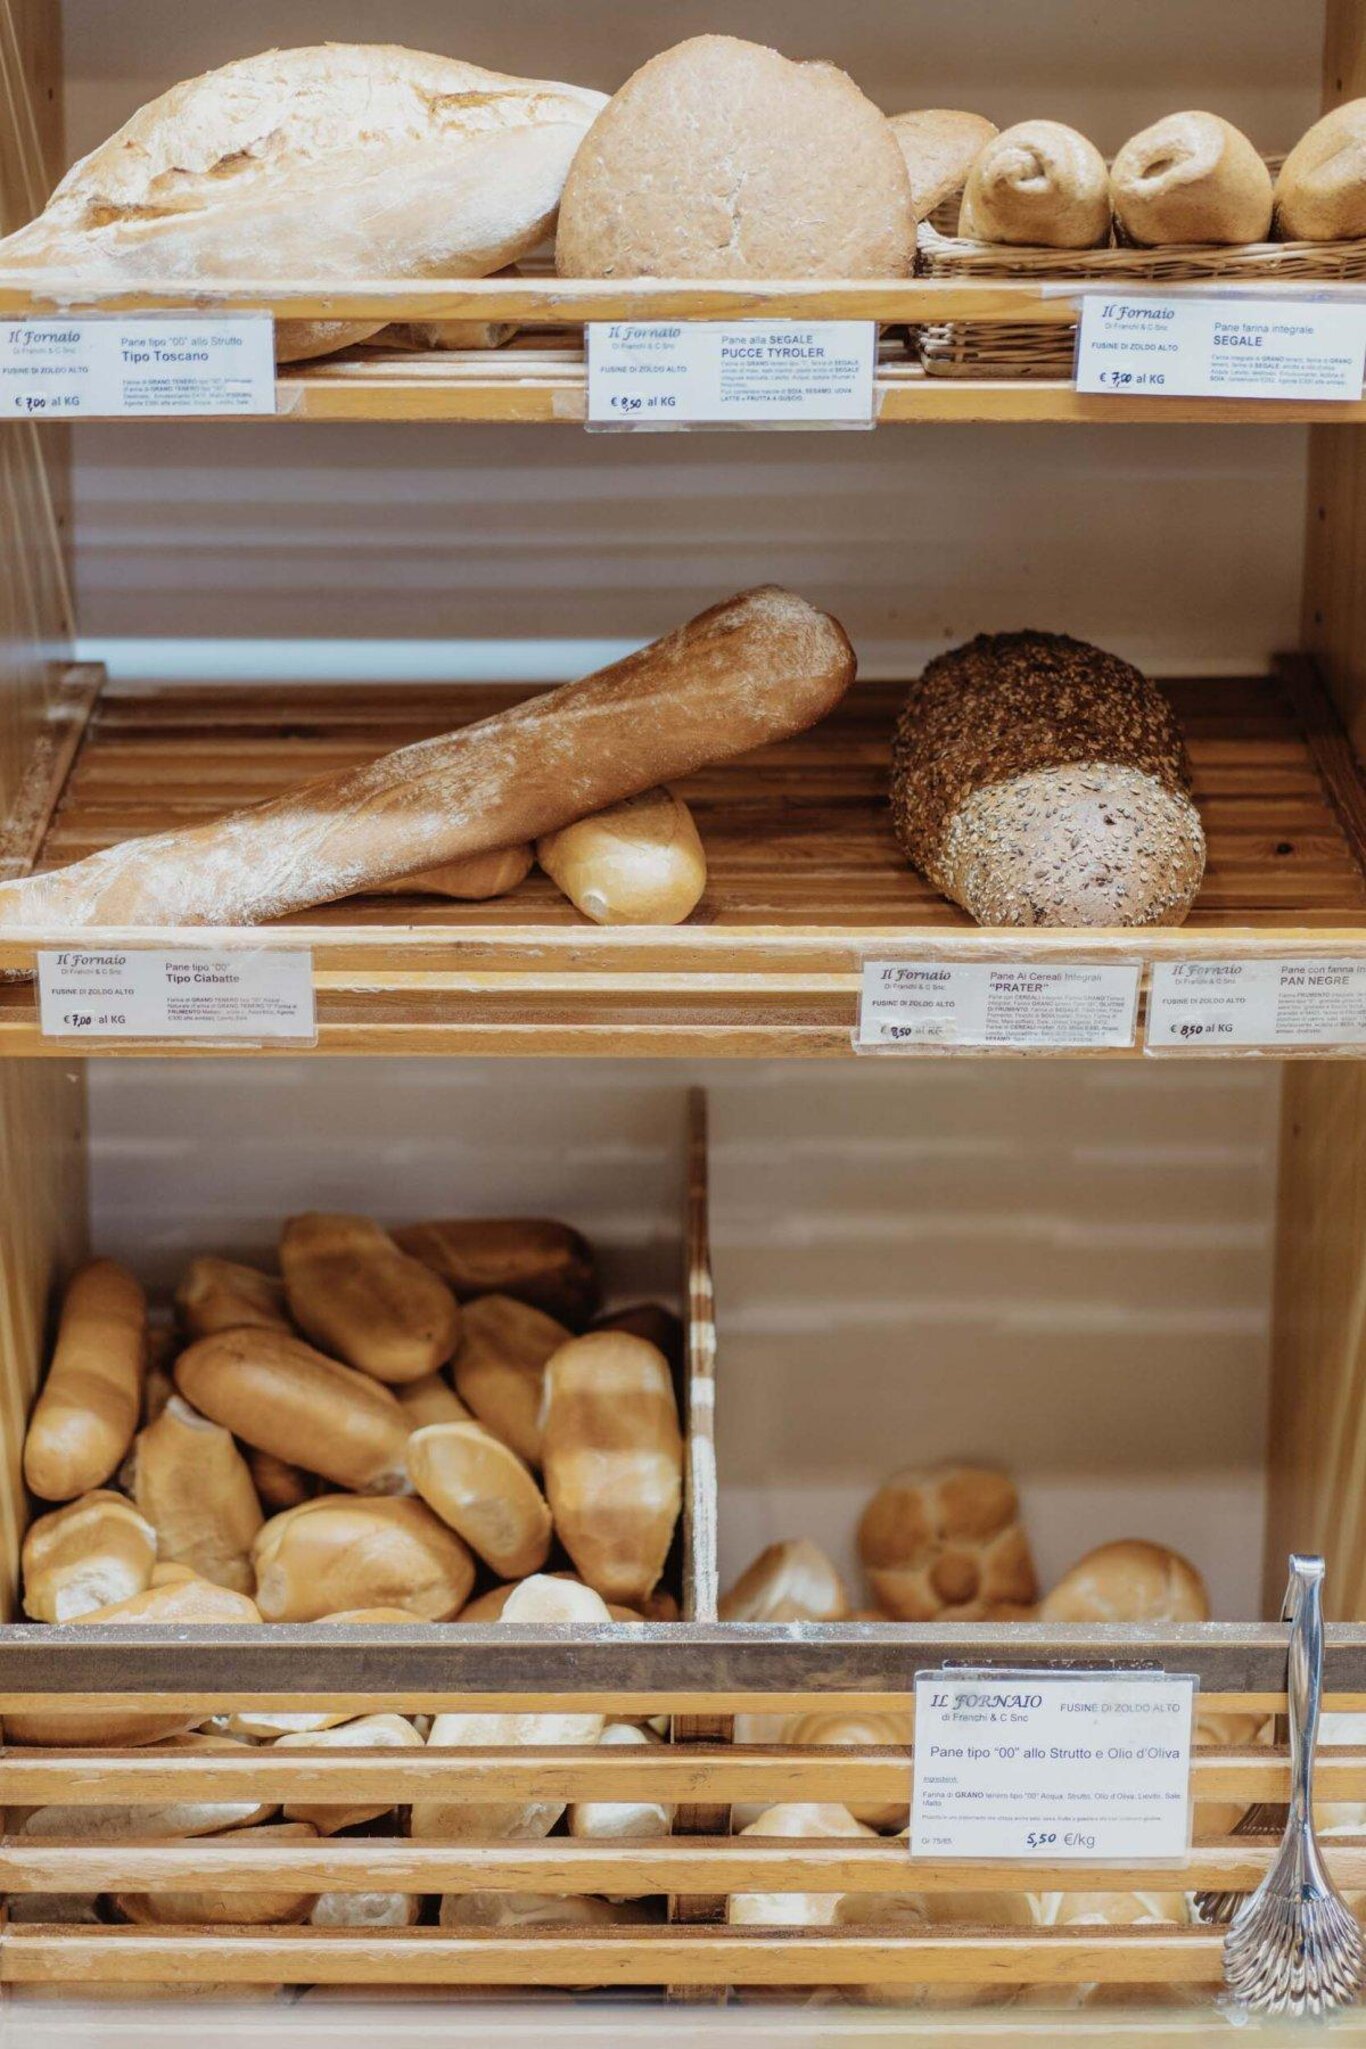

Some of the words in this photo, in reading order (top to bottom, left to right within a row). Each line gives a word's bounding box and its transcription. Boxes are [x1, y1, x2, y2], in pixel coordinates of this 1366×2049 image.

[1102, 304, 1117, 317] Il
[1117, 306, 1174, 320] Fornaio
[1215, 322, 1239, 332] Pane
[1243, 323, 1268, 333] farina
[1272, 325, 1314, 335] integrale
[121, 338, 145, 346] Pane
[149, 338, 166, 348] tipo
[191, 337, 207, 346] allo
[211, 337, 242, 346] Strutto
[722, 336, 746, 344] Pane
[750, 336, 766, 344] alla
[770, 336, 813, 344] SEGALE
[1214, 336, 1263, 346] SEGALE
[122, 351, 149, 363] Tipo
[154, 351, 208, 361] Toscano
[722, 348, 762, 358] PUCCE
[768, 348, 824, 358] TYROLER
[1100, 372, 1106, 382] €
[1136, 374, 1146, 383] al
[1150, 374, 1164, 384] KG
[15, 397, 22, 406] €
[52, 397, 60, 405] al
[65, 396, 79, 405] KG
[611, 397, 617, 406] €
[648, 397, 657, 406] al
[661, 397, 676, 406] KG
[57, 954, 70, 965] Il
[71, 955, 126, 967] Fornaio
[166, 963, 189, 971] Pane
[192, 963, 209, 973] tipo
[166, 974, 190, 984] Tipo
[194, 974, 239, 983] Ciabatte
[881, 968, 895, 979] Il
[895, 969, 951, 981] Fornaio
[990, 972, 1014, 980] Pane
[1030, 973, 1061, 981] Cereali
[1280, 977, 1304, 985] PAN
[1308, 976, 1350, 985] NEGRE
[64, 1015, 70, 1023] €
[99, 1015, 107, 1023] al
[111, 1015, 125, 1023] KG
[1171, 1025, 1176, 1033] €
[1205, 1024, 1214, 1032] al
[1218, 1024, 1233, 1032] KG
[931, 1695, 948, 1708] IL
[952, 1695, 1042, 1710] FORNAIO
[1060, 1704, 1098, 1712] FUSINE
[1102, 1704, 1113, 1712] DI
[1115, 1704, 1150, 1712] ZOLDO
[1153, 1704, 1180, 1712] ALTO
[942, 1713, 950, 1721] di
[990, 1714, 997, 1722] &
[1000, 1714, 1007, 1722] C
[1011, 1714, 1028, 1722] Snc
[931, 1747, 963, 1758] Pane
[967, 1747, 990, 1761] tipo
[1024, 1749, 1046, 1758] allo
[1050, 1749, 1092, 1759] Strutto
[1108, 1749, 1133, 1759] Olio
[1027, 1832, 1057, 1848] 5,50
[1064, 1832, 1095, 1849] €/kg
